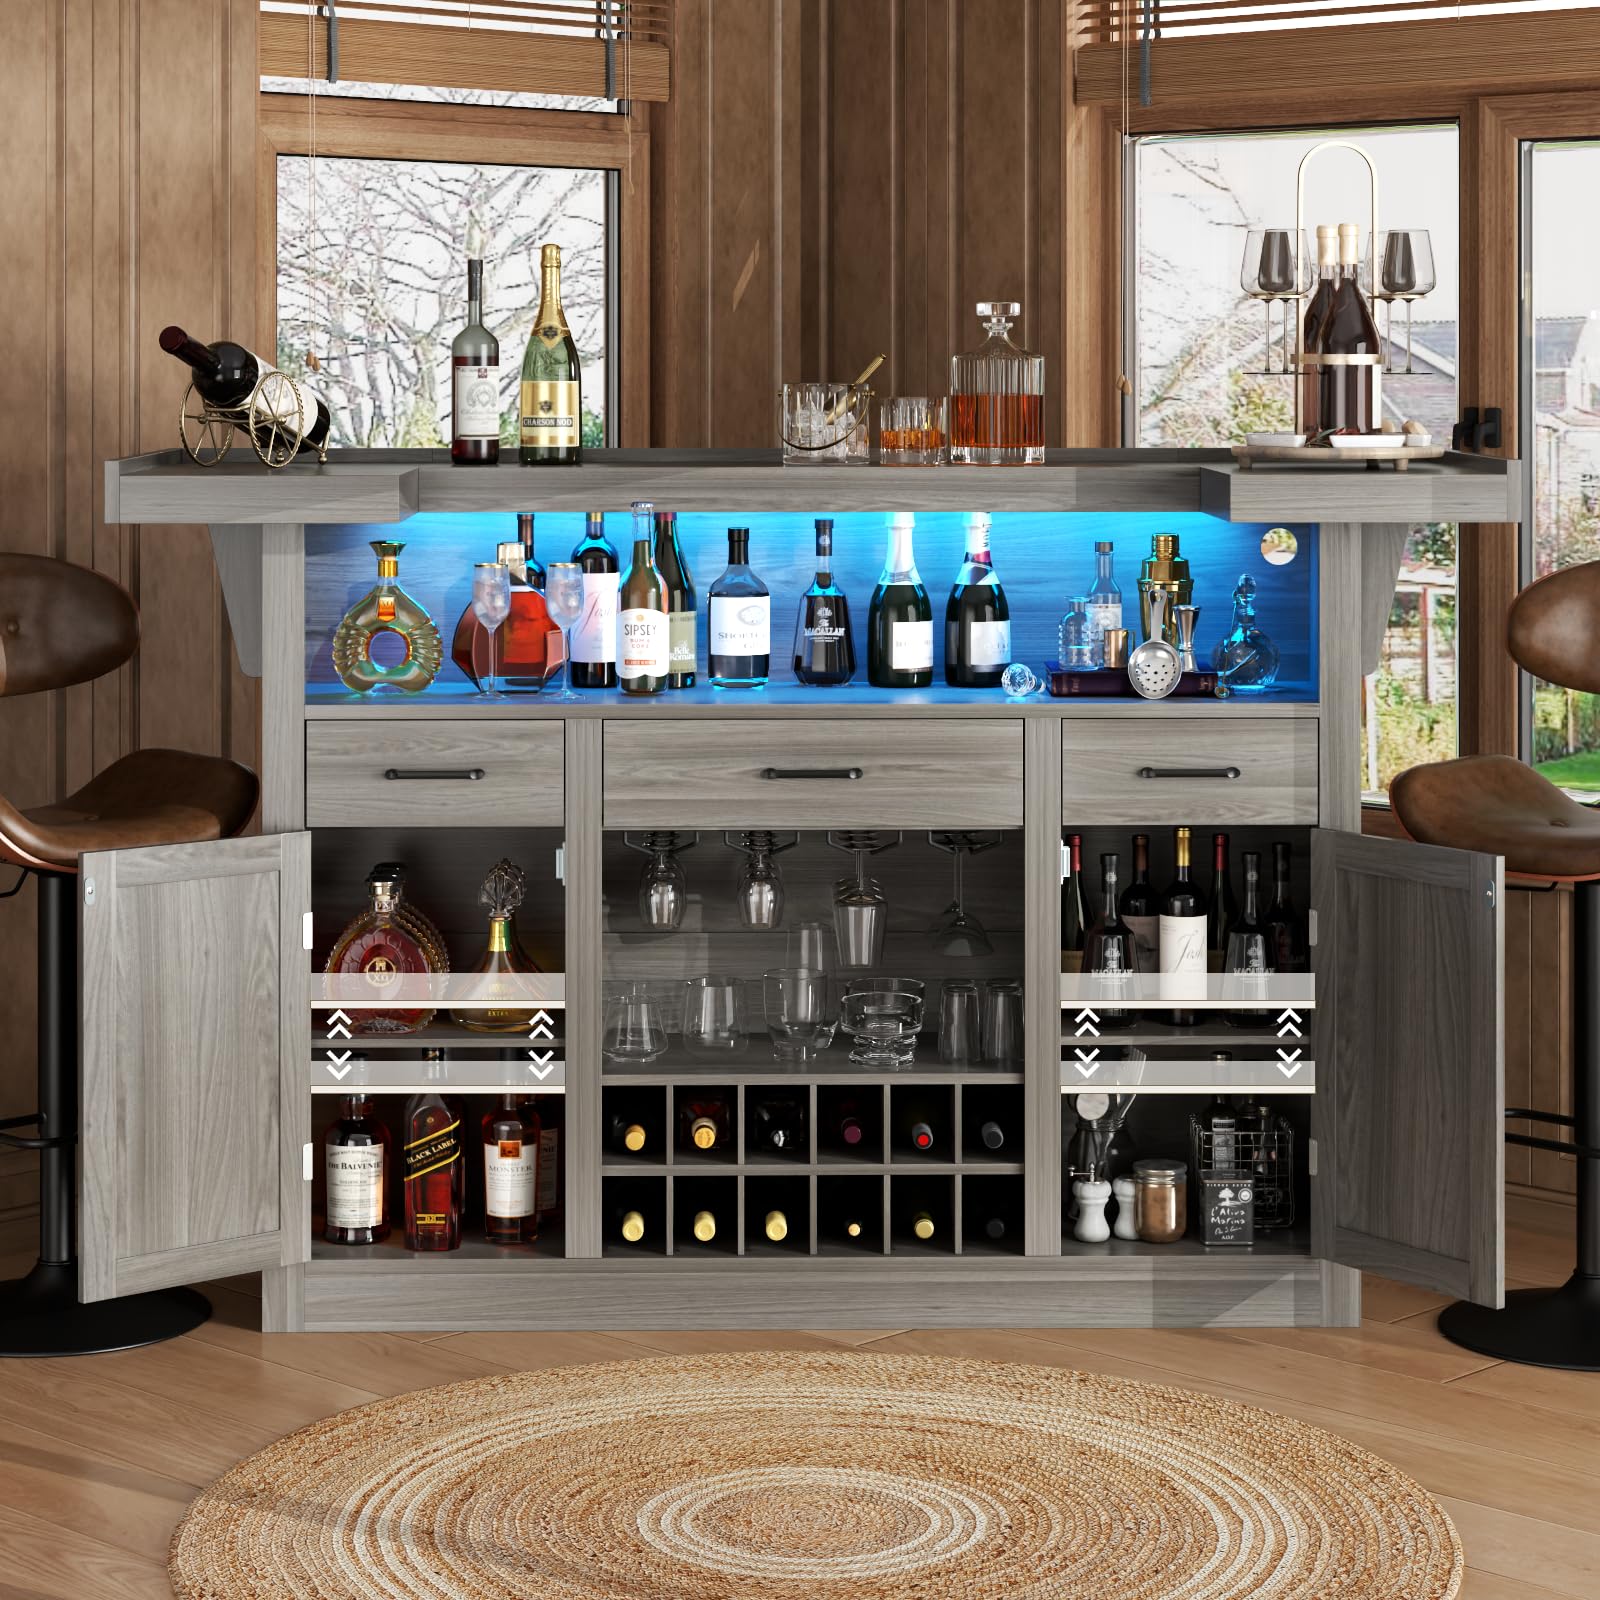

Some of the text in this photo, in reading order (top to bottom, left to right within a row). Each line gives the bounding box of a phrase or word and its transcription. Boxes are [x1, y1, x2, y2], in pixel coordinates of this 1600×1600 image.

[523, 418, 555, 426] CHARSON
[624, 624, 656, 636] SIPSEY
[406, 1149, 432, 1164] BLACK
[431, 1138, 457, 1153] LABEL
